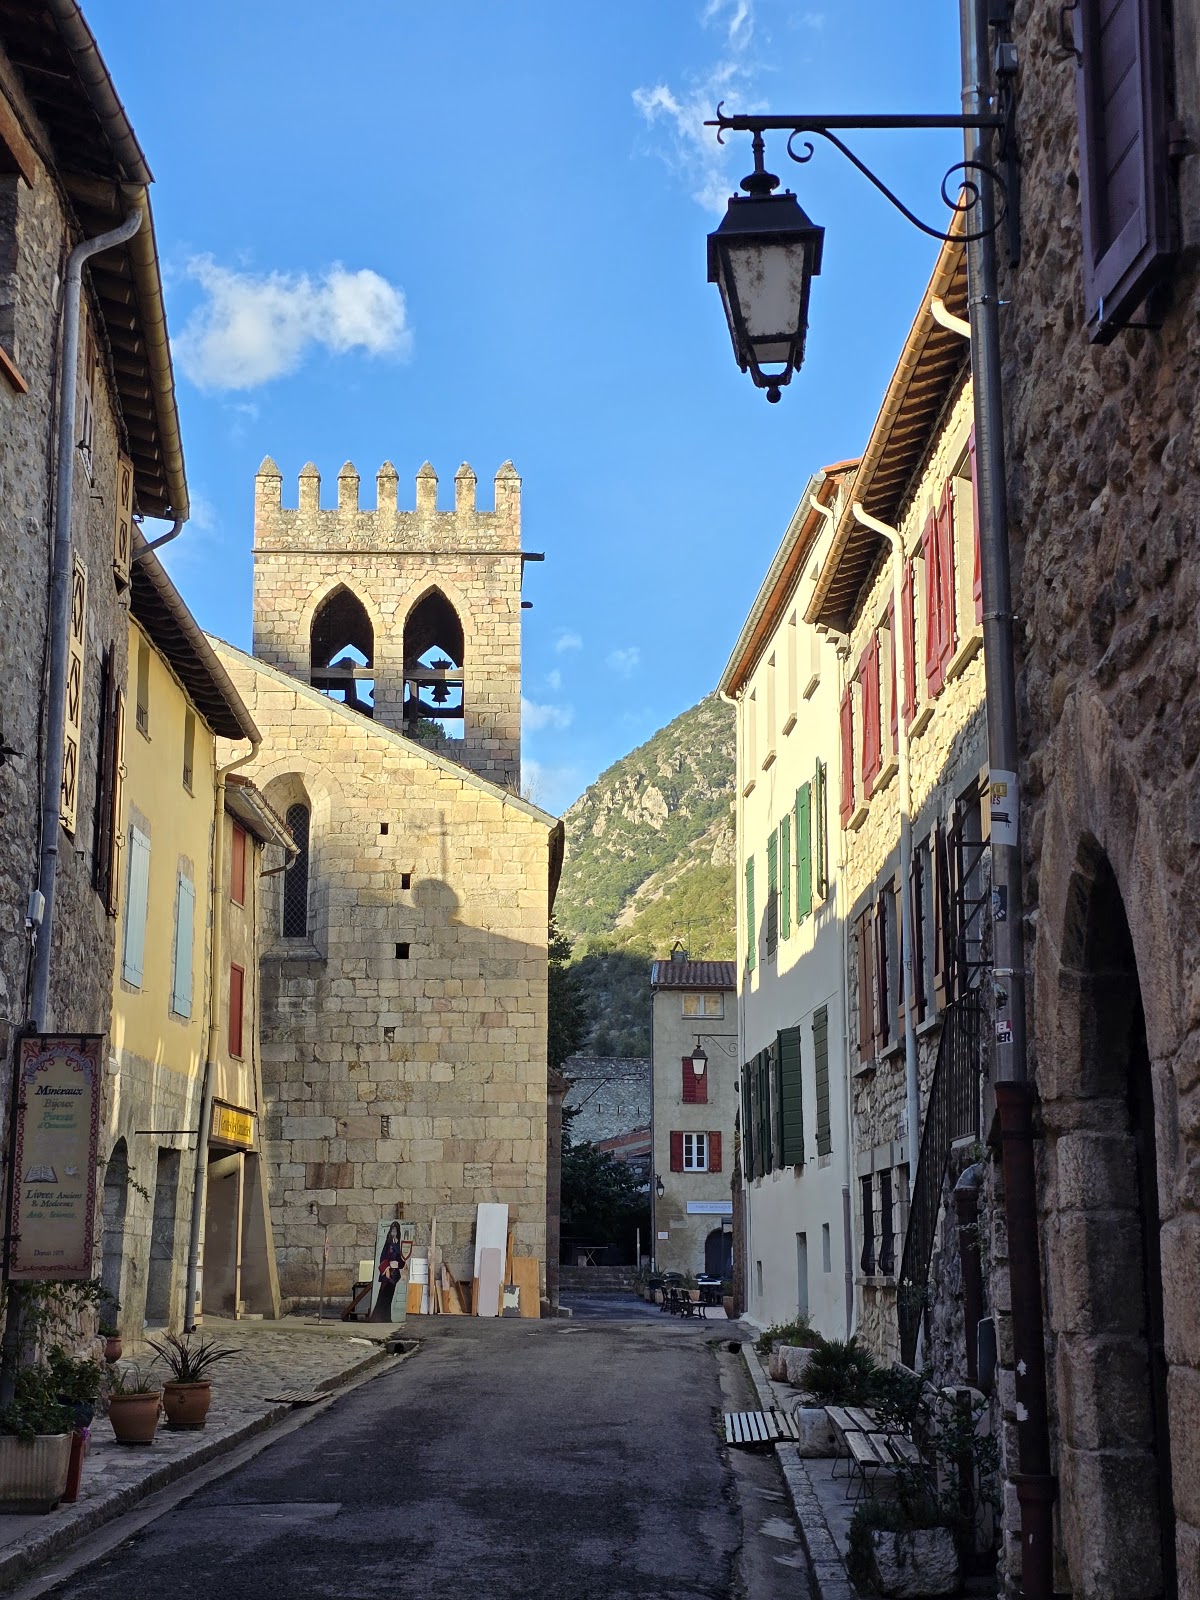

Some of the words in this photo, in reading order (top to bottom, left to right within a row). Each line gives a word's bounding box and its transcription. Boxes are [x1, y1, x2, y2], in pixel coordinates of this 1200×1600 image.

[34, 1085, 83, 1096] Minéraux
[43, 1099, 74, 1110] Bijoux
[25, 1189, 55, 1199] Livres
[40, 1200, 74, 1208] Modernes
[34, 1249, 52, 1257] Depuis
